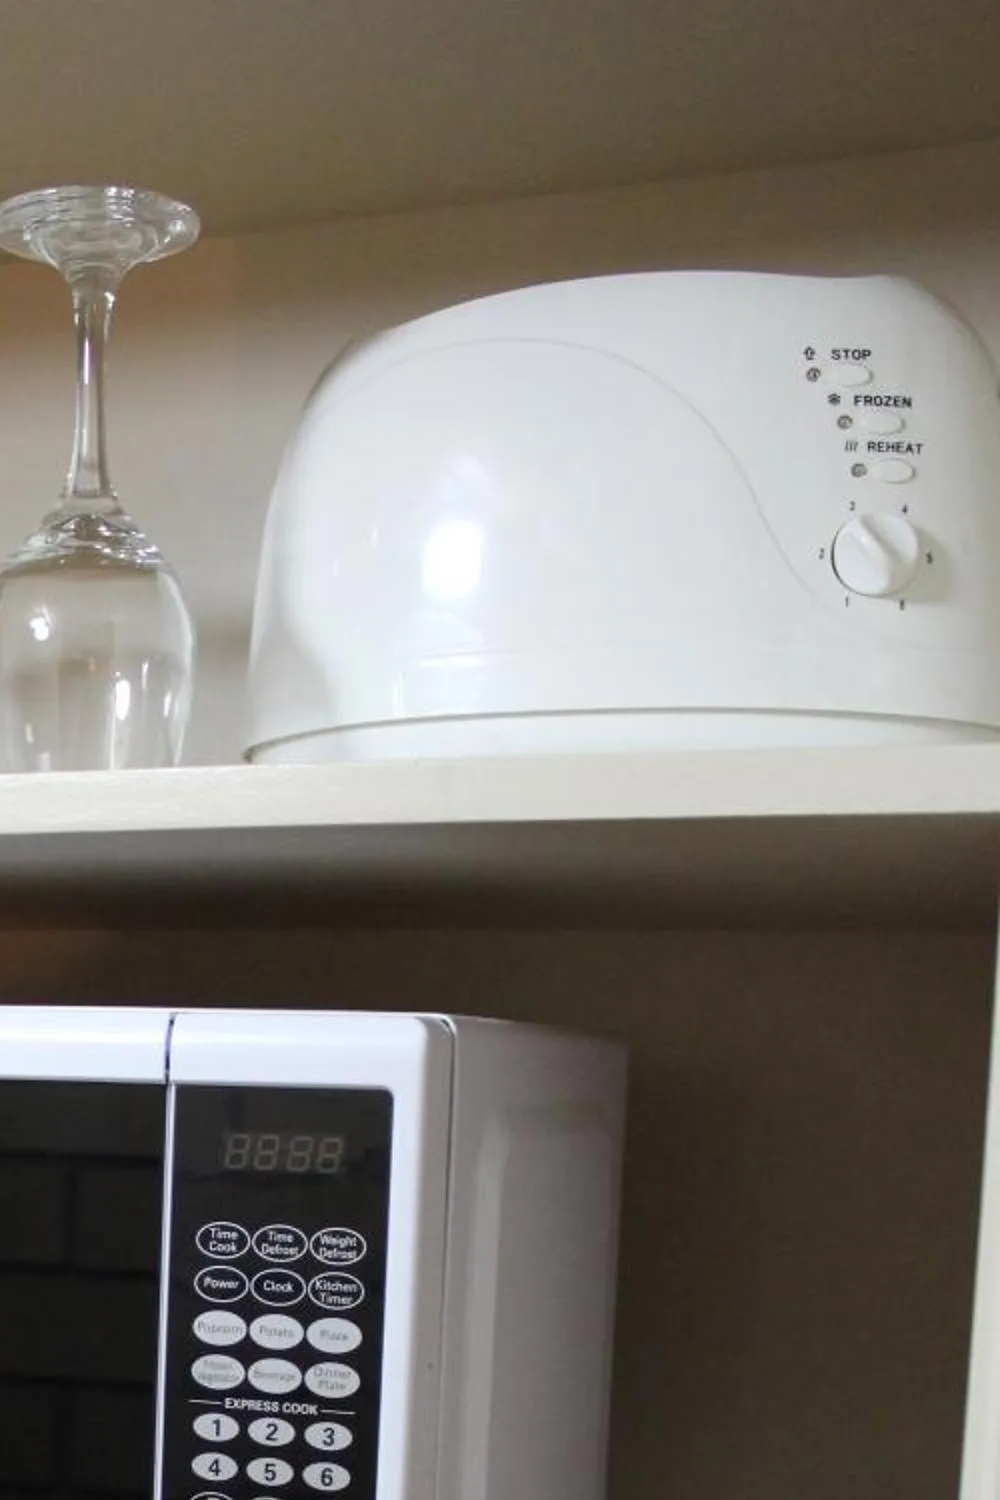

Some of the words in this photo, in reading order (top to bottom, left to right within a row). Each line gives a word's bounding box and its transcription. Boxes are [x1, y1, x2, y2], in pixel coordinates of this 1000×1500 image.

[831, 349, 872, 361] STOP
[853, 395, 913, 409] FROZEN
[867, 441, 923, 455] REHEAT
[208, 1227, 239, 1241] Time
[268, 1231, 294, 1243] Time
[319, 1234, 357, 1248] Weight
[208, 1240, 238, 1252] Cook
[261, 1244, 299, 1256] Defrost
[319, 1247, 357, 1260] Defrost
[203, 1276, 240, 1290] Power
[263, 1280, 295, 1293] Clock
[315, 1279, 358, 1293] Kitchen
[319, 1293, 353, 1305] Timer
[224, 1398, 280, 1413] EXPRESS
[282, 1403, 319, 1416] COOK
[212, 1419, 221, 1437] 1
[265, 1423, 278, 1441] 2
[322, 1427, 335, 1446] 3
[208, 1458, 221, 1476] 4
[264, 1463, 276, 1481] 5
[320, 1468, 333, 1486] 6
